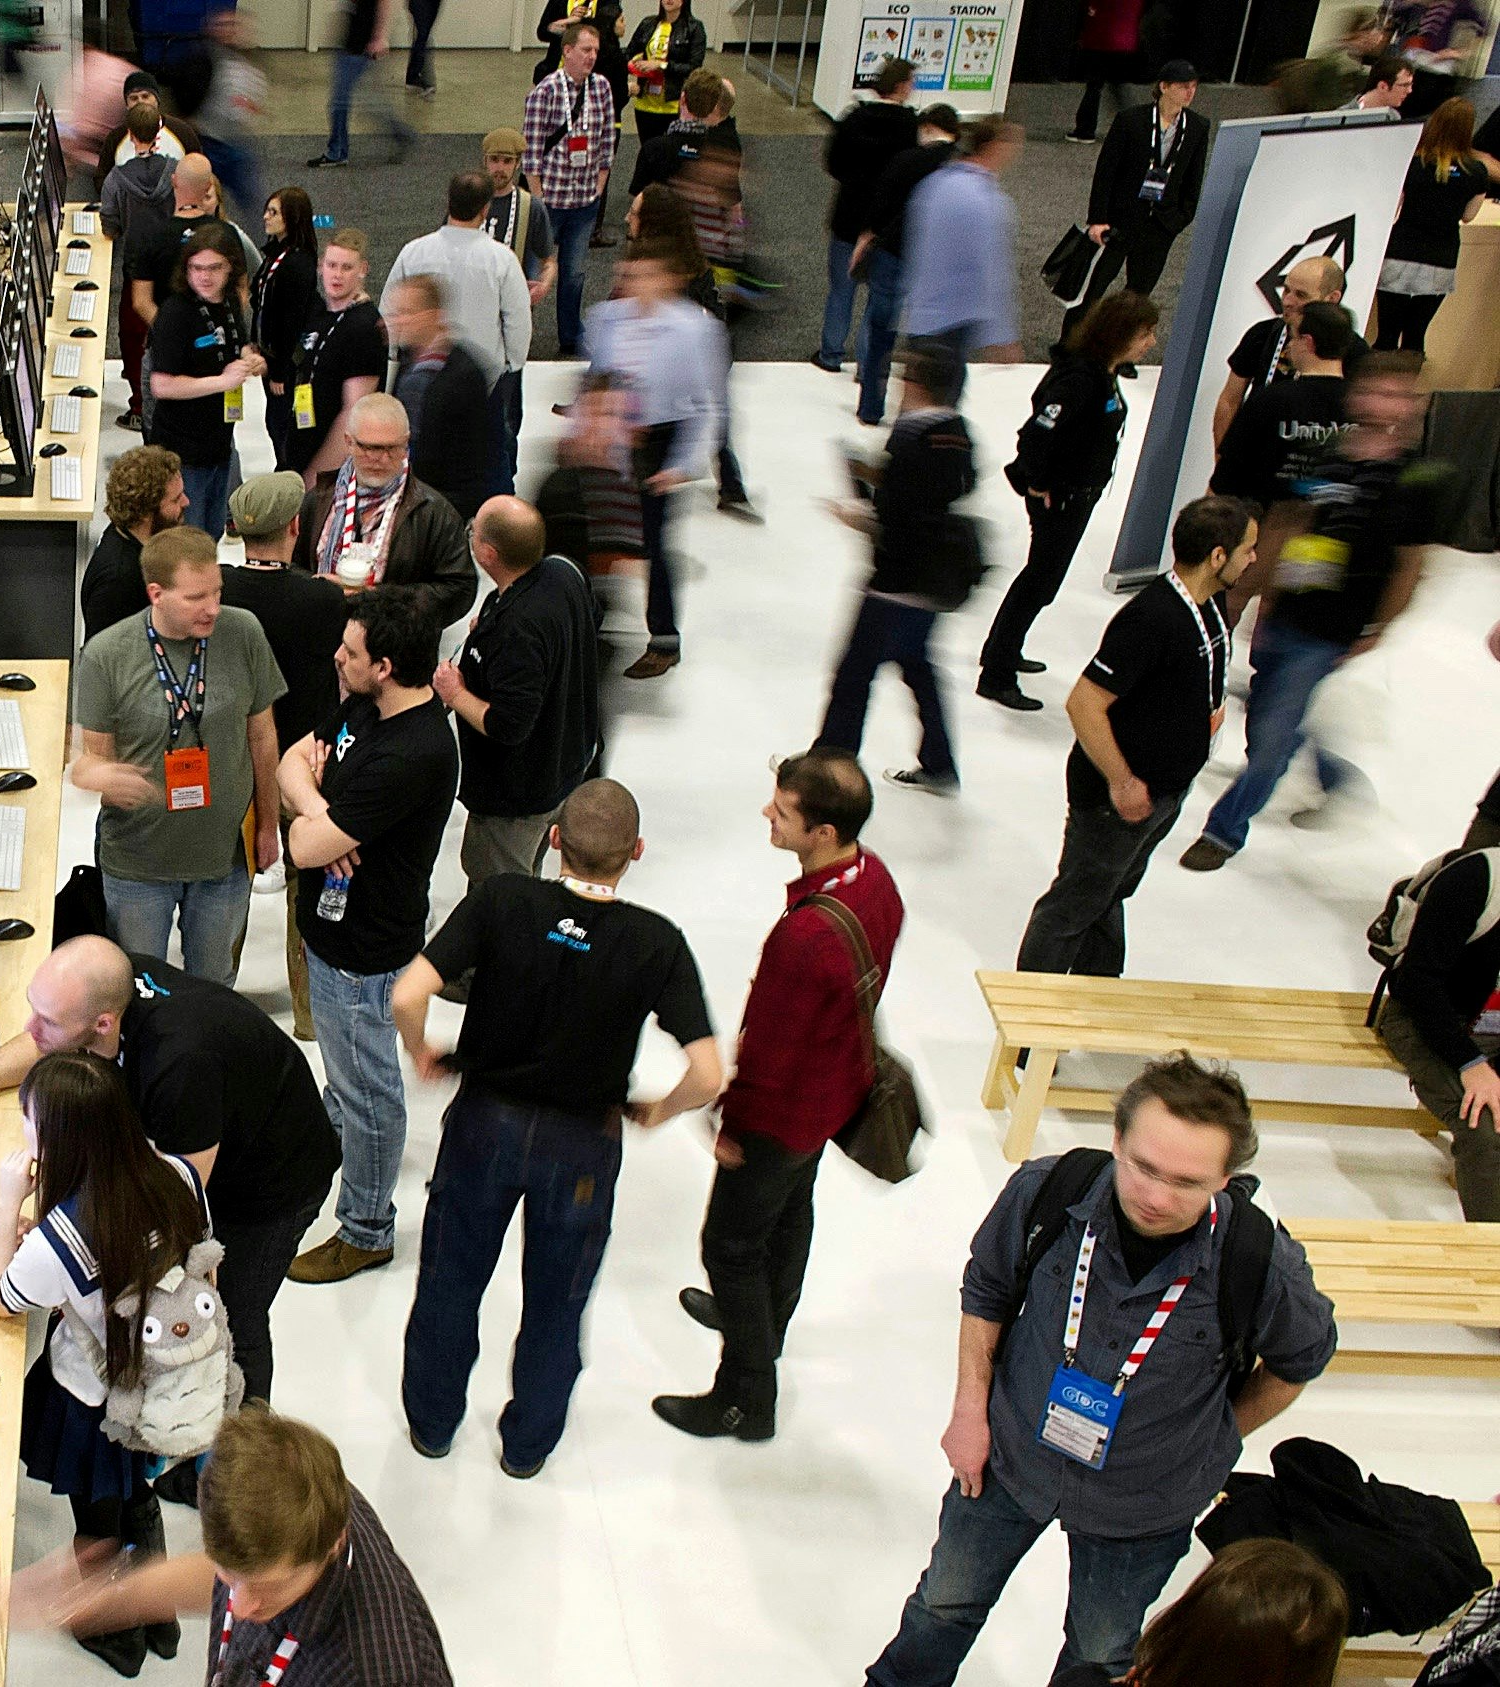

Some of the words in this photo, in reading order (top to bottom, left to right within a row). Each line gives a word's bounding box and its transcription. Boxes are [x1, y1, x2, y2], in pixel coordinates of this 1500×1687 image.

[887, 4, 910, 15] ECO
[950, 5, 997, 16] STATION
[1062, 1386, 1109, 1418] GDC
